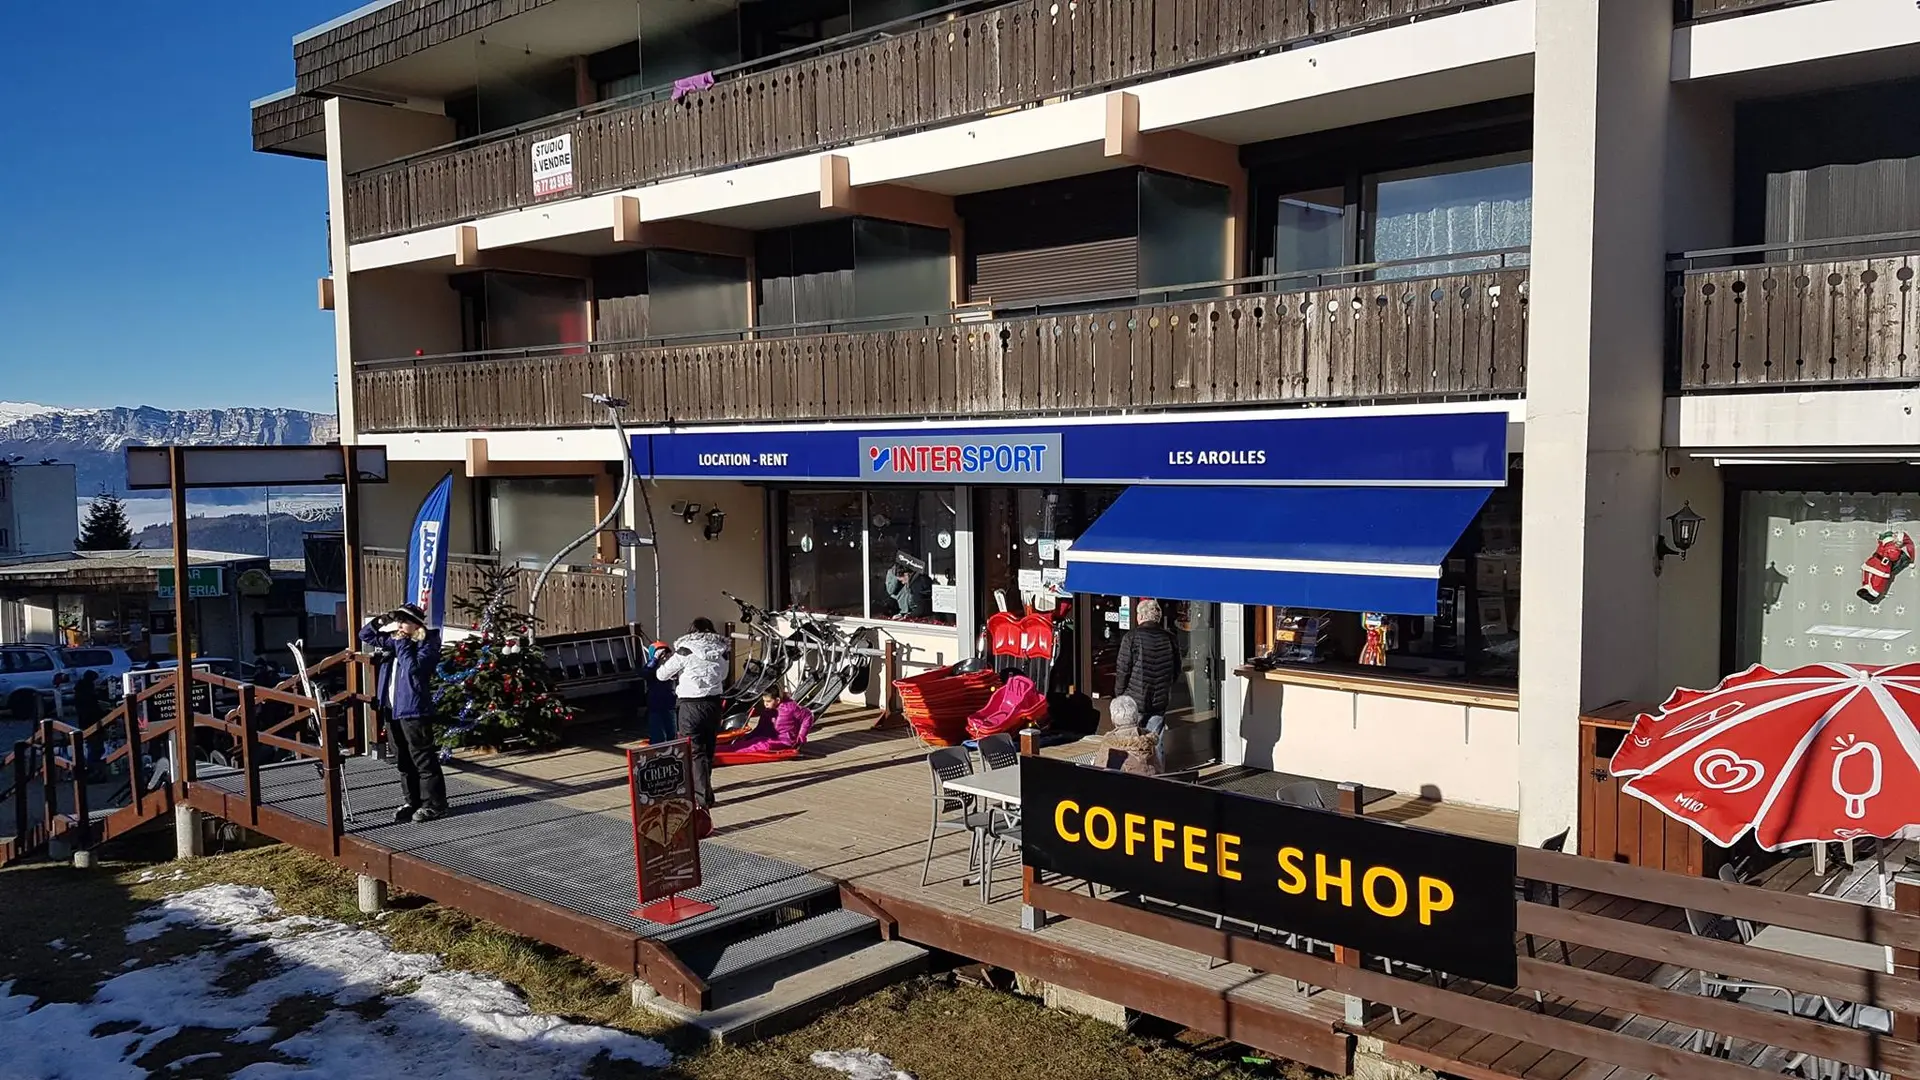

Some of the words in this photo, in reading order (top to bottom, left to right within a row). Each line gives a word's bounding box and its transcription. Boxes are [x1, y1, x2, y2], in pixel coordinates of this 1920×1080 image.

[536, 139, 564, 157] STUDIO
[539, 153, 571, 171] VENDRE
[698, 453, 751, 466] LOCATION
[760, 453, 789, 466] RENT
[892, 444, 1047, 473] INTERSPORT
[1168, 451, 1193, 465] LES
[1197, 450, 1266, 464] AROLLES
[1674, 792, 1704, 812] MIKO
[1054, 799, 1243, 882] COFFEE
[1276, 846, 1456, 926] SHOP
